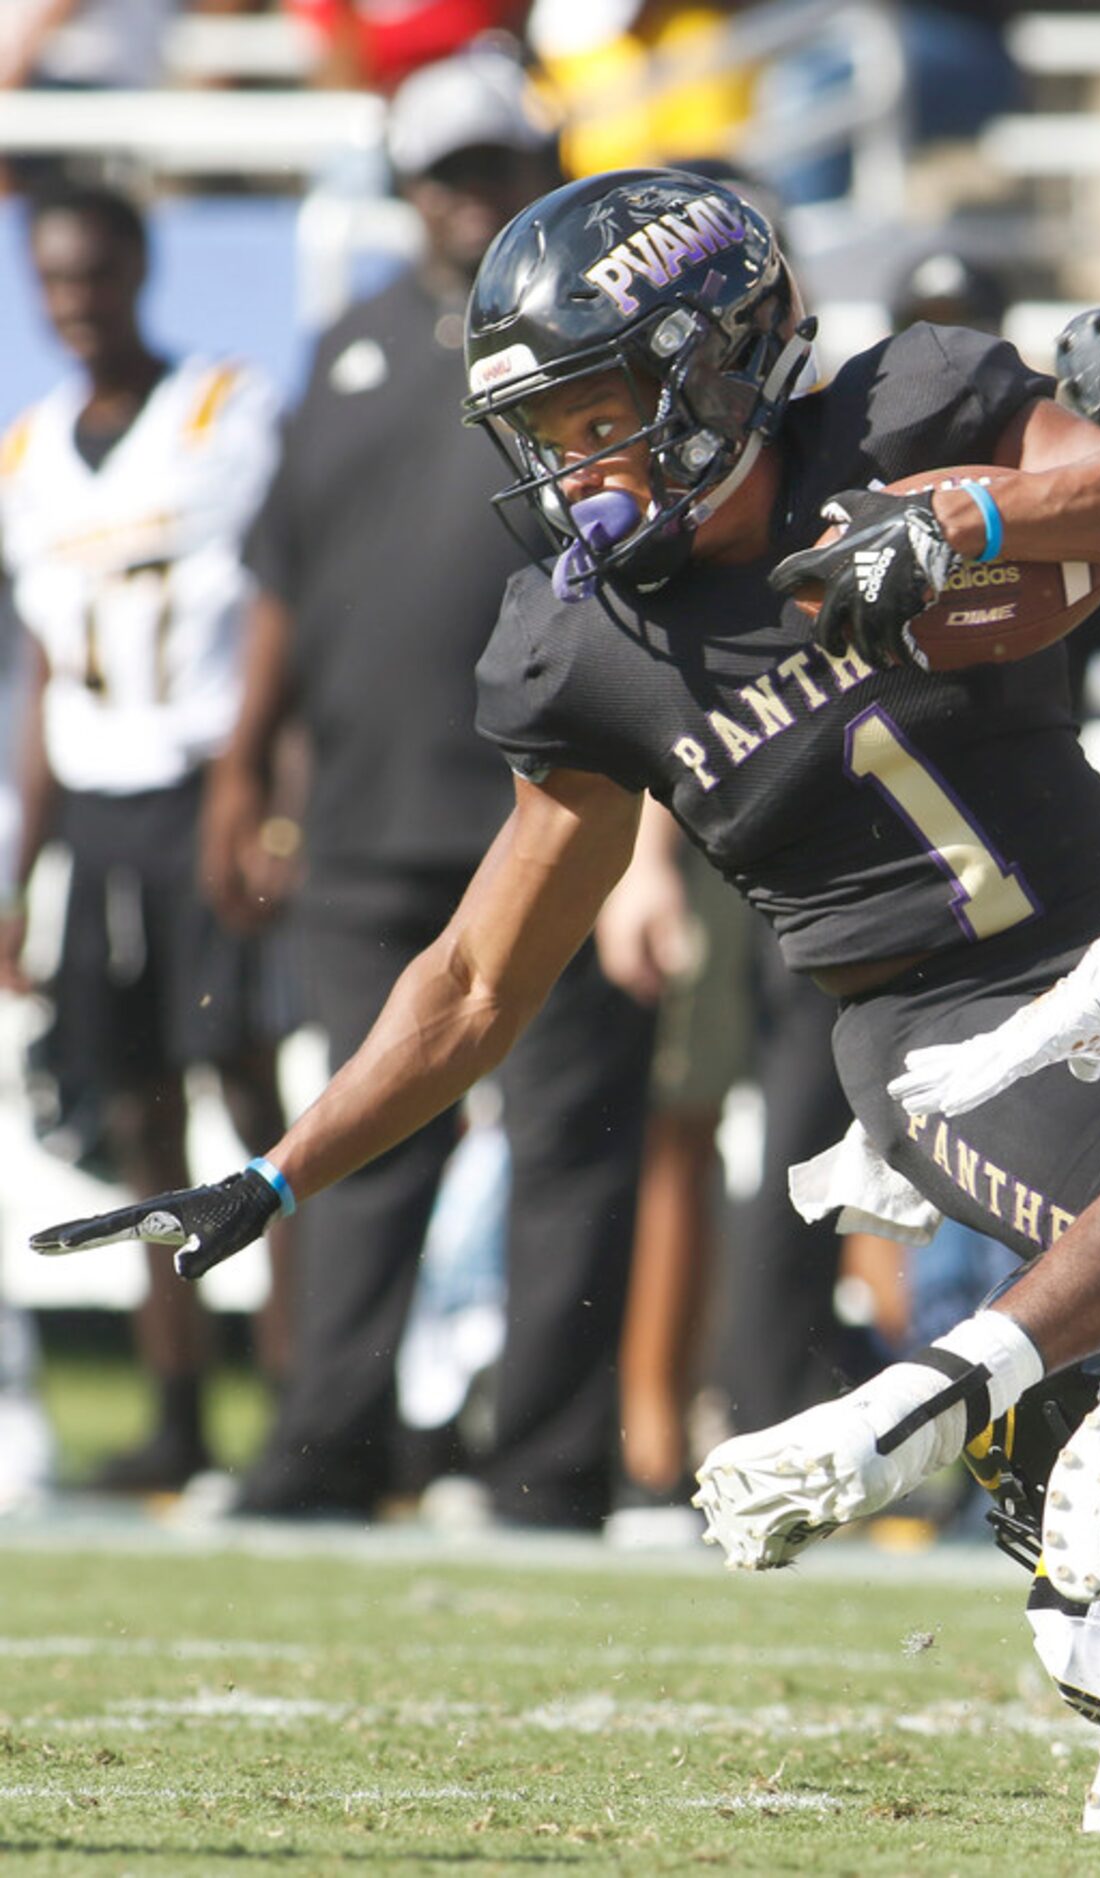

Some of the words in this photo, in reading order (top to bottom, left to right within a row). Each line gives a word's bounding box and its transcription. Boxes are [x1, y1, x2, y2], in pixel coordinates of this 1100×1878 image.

[583, 196, 745, 316] PVAMU
[946, 603, 1016, 626] DIME
[846, 703, 1041, 942] 1
